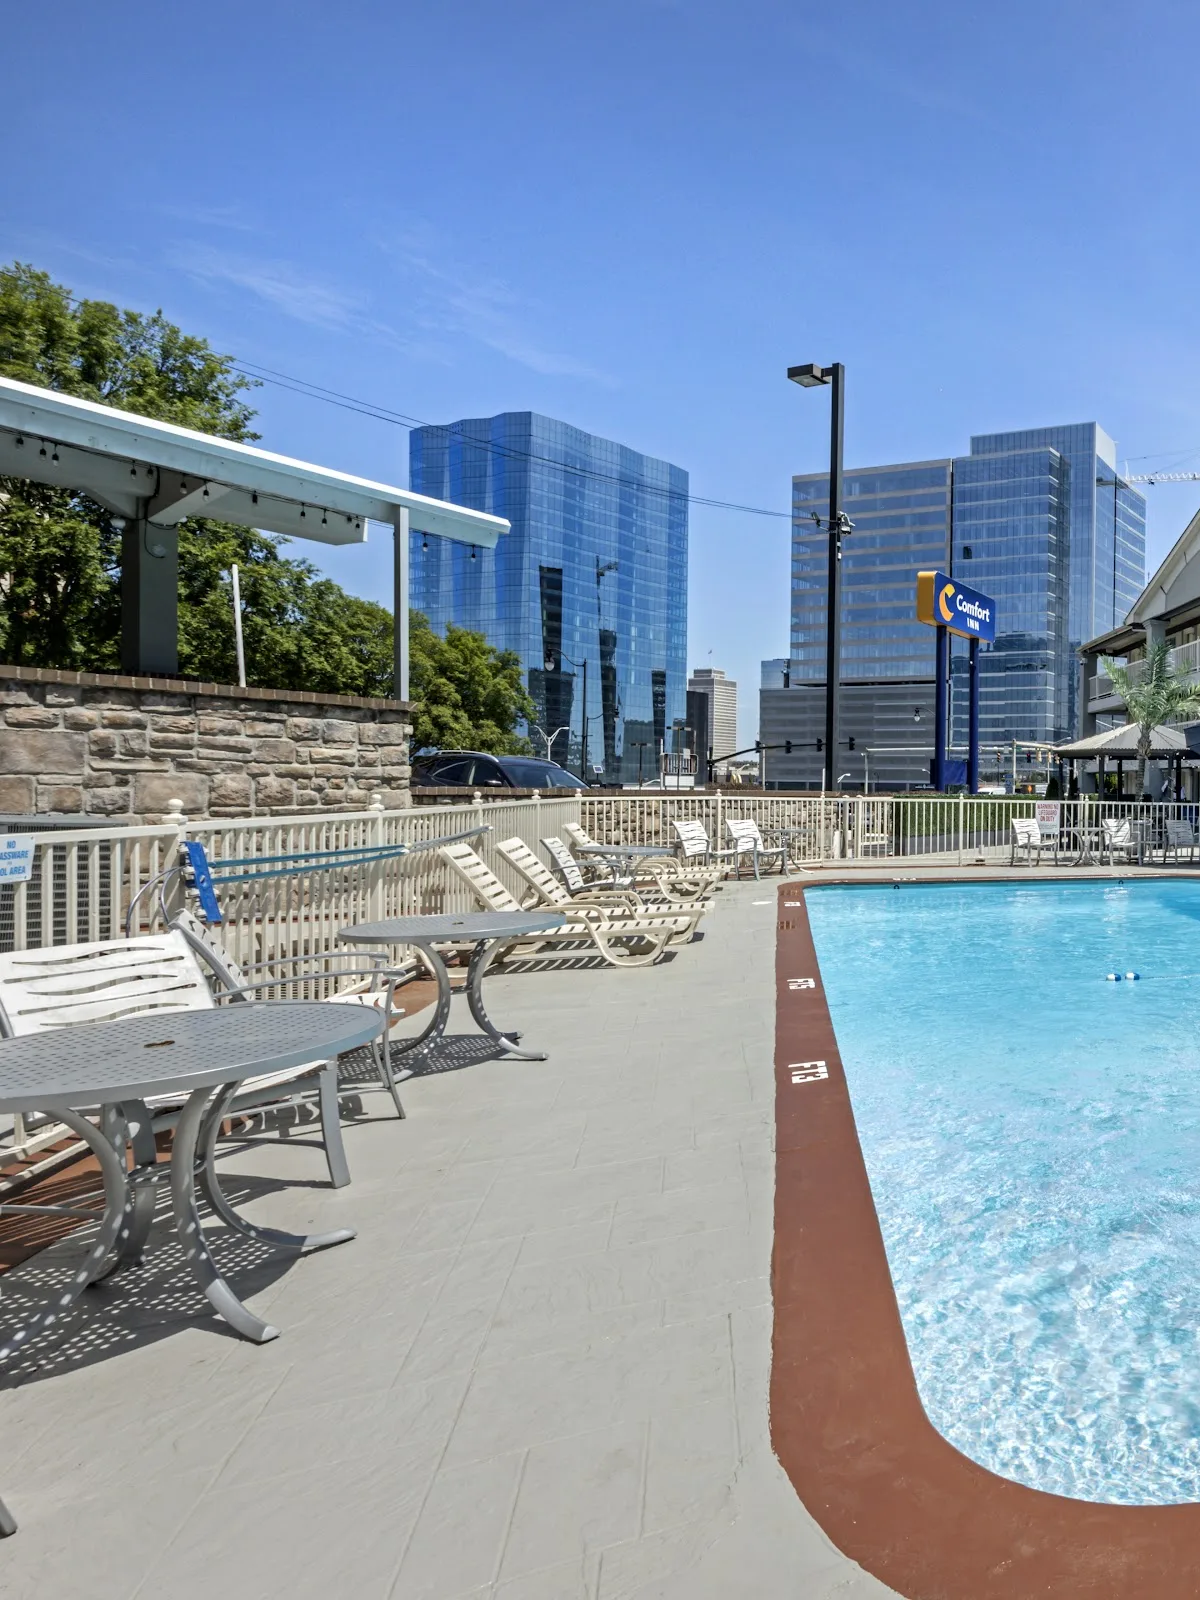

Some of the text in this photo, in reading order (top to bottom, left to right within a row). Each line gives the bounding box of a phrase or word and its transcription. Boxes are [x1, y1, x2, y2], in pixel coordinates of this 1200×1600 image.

[956, 594, 990, 623] Comfort
[966, 617, 980, 631] INN
[7, 840, 16, 849] NO
[0, 850, 29, 860] ASSWARE
[9, 865, 26, 875] AREA
[788, 1060, 829, 1084] FT3
